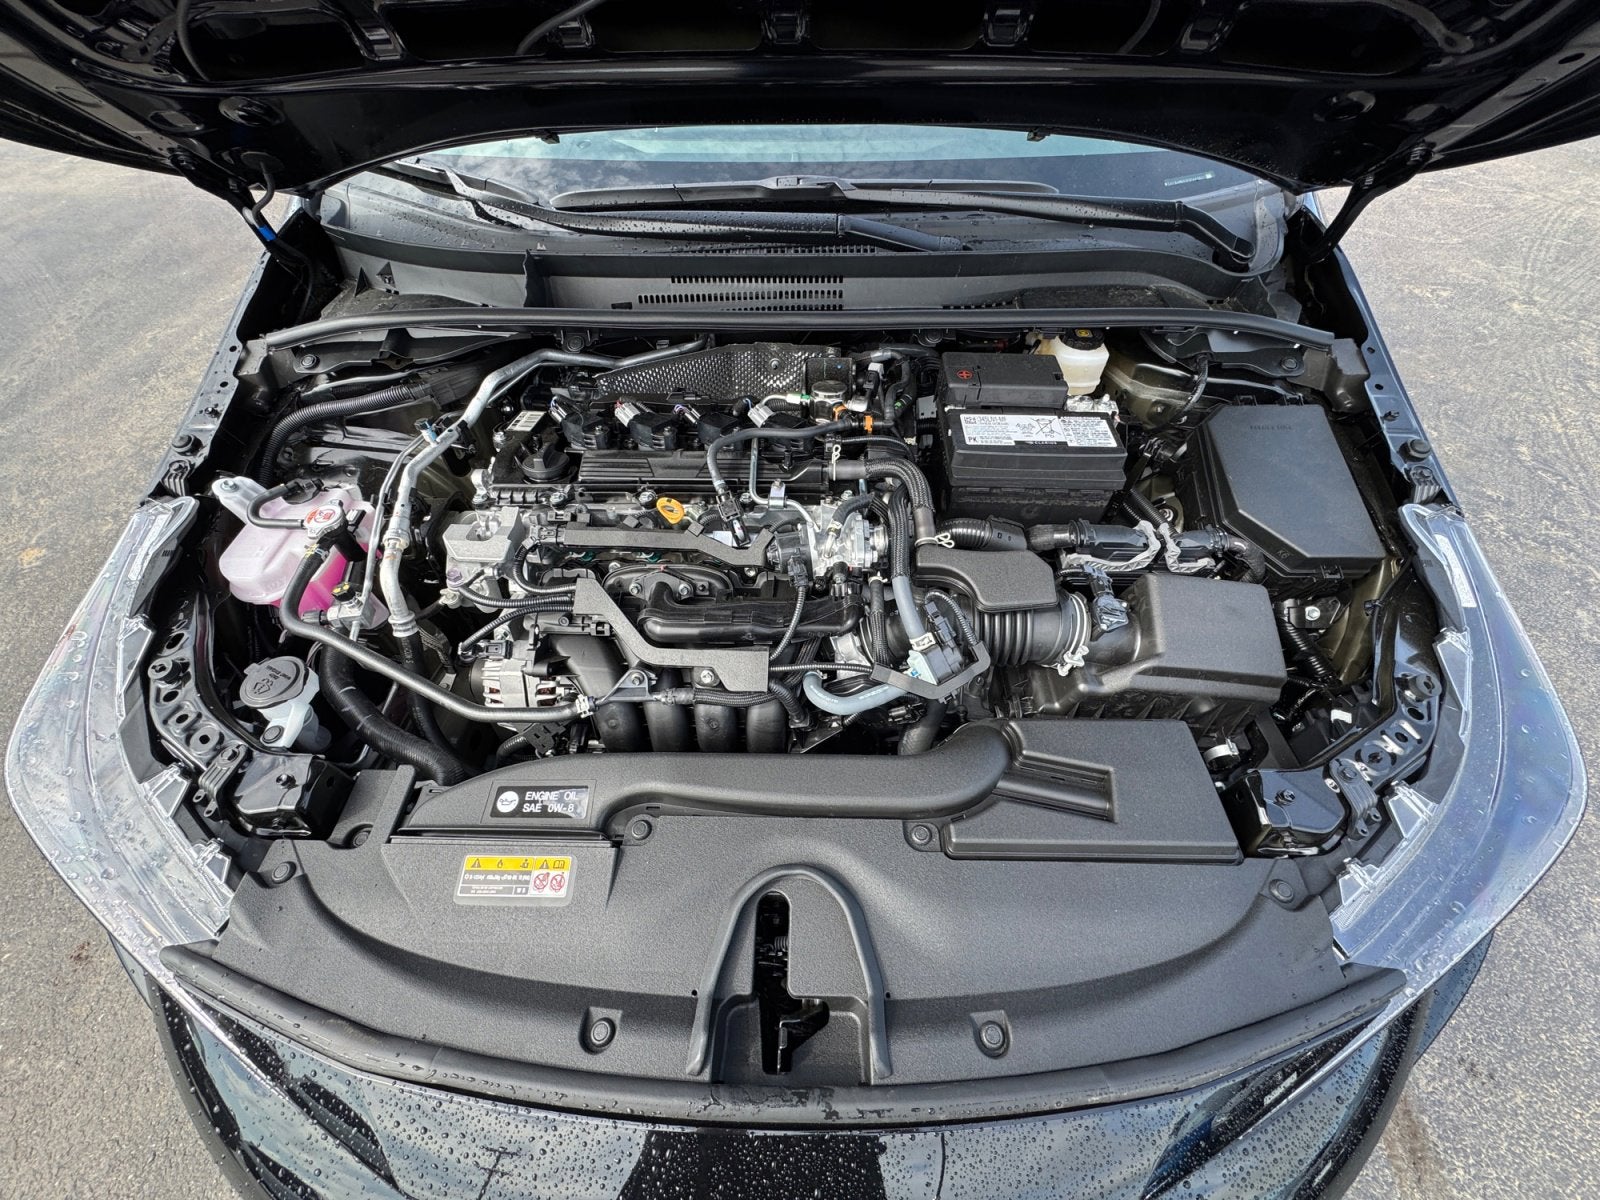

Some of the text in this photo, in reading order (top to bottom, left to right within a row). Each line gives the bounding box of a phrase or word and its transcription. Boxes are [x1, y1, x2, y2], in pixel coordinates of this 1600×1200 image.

[525, 791, 578, 800] ENGINE OIL
[522, 803, 574, 812] SAE 0W-8
